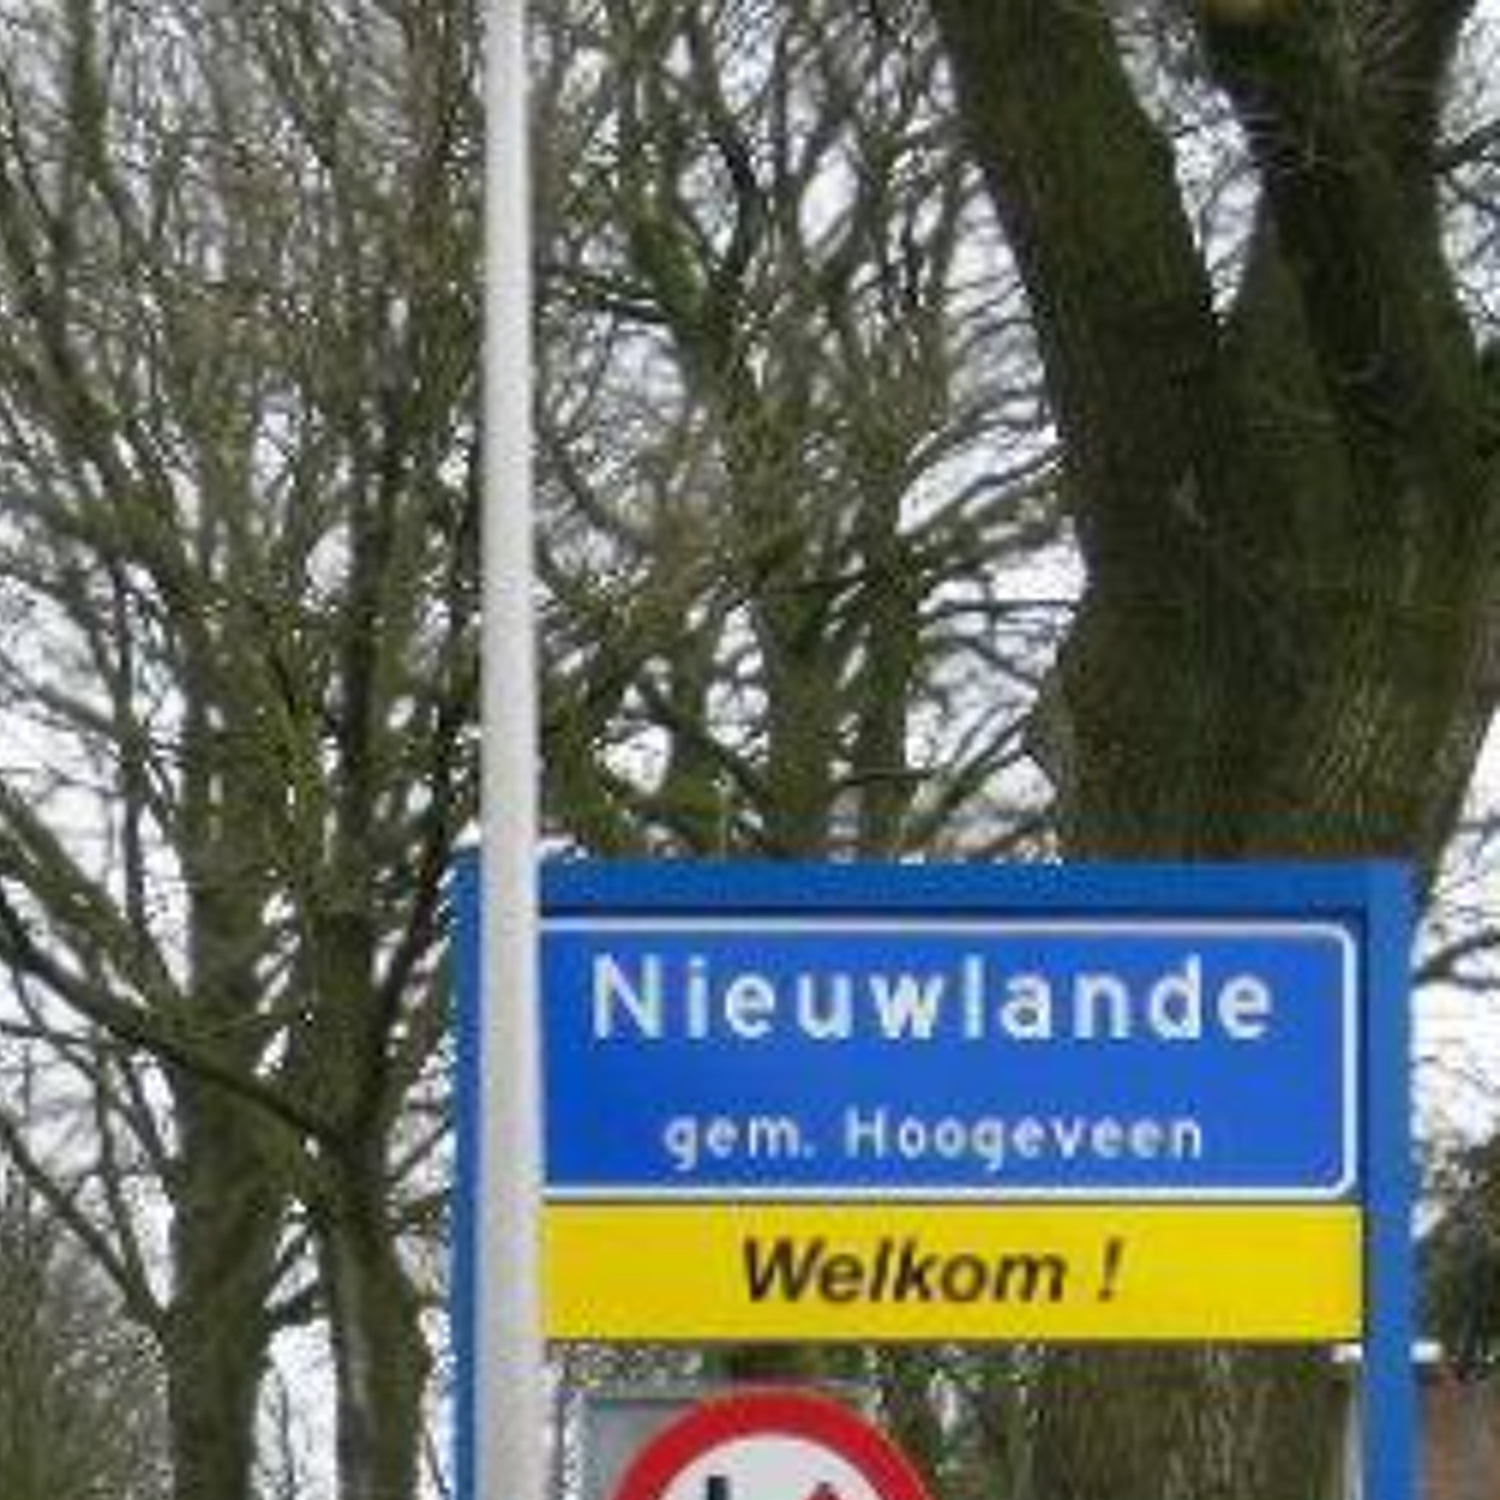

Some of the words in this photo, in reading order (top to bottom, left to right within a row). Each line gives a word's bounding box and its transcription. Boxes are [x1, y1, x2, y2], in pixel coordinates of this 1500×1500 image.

[592, 954, 1272, 1041] Nieuwlande
[663, 1116, 816, 1170] gem.
[845, 1109, 1203, 1171] Hoogeveen
[741, 1239, 1067, 1304] Welkom
